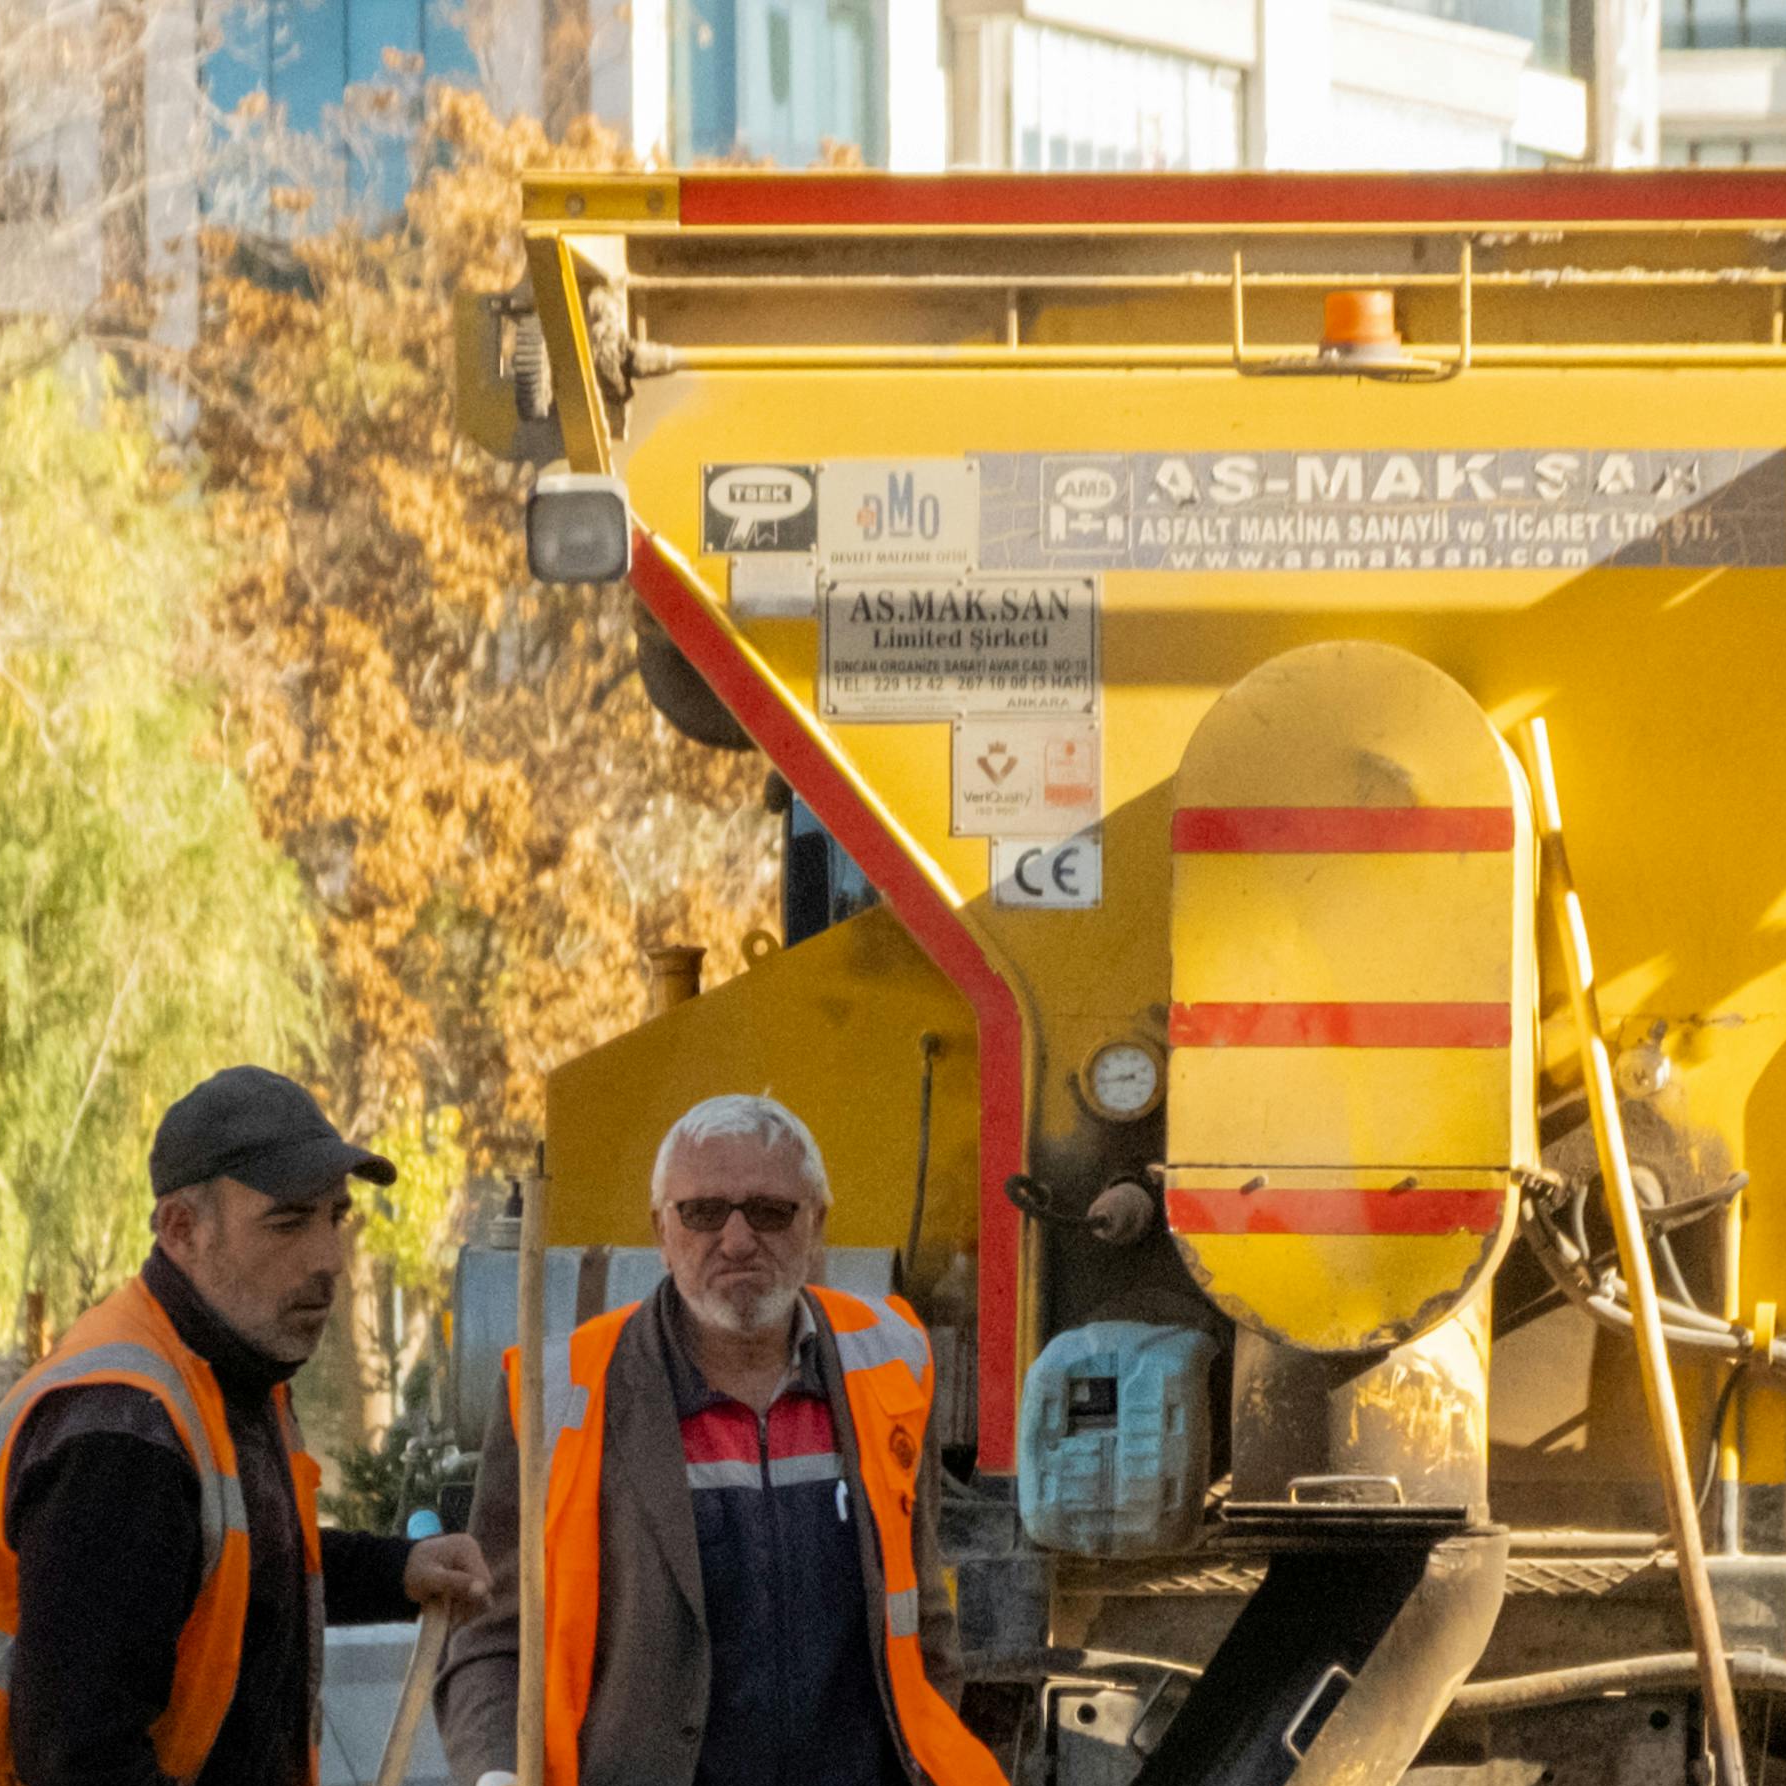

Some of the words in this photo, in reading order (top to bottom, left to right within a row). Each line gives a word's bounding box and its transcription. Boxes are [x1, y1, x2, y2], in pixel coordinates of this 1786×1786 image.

[1066, 478, 1110, 498] AMS
[862, 471, 940, 541] DMO
[1139, 516, 1231, 544] ASFALT
[1241, 511, 1351, 543] MAKİNA
[1458, 518, 1485, 541] ve
[1493, 511, 1602, 541] TİCARET
[830, 551, 872, 564] DEVLET
[1170, 545, 1589, 570] www.asmaksan.com
[850, 588, 1071, 624] AS.MAK.SAN
[873, 628, 962, 649] Limited
[969, 626, 1049, 652] Şirketi
[874, 675, 900, 692] 229
[907, 675, 921, 692] 12
[927, 675, 944, 692] 42
[1007, 697, 1070, 708] ANKARA
[1015, 847, 1080, 897] CE
